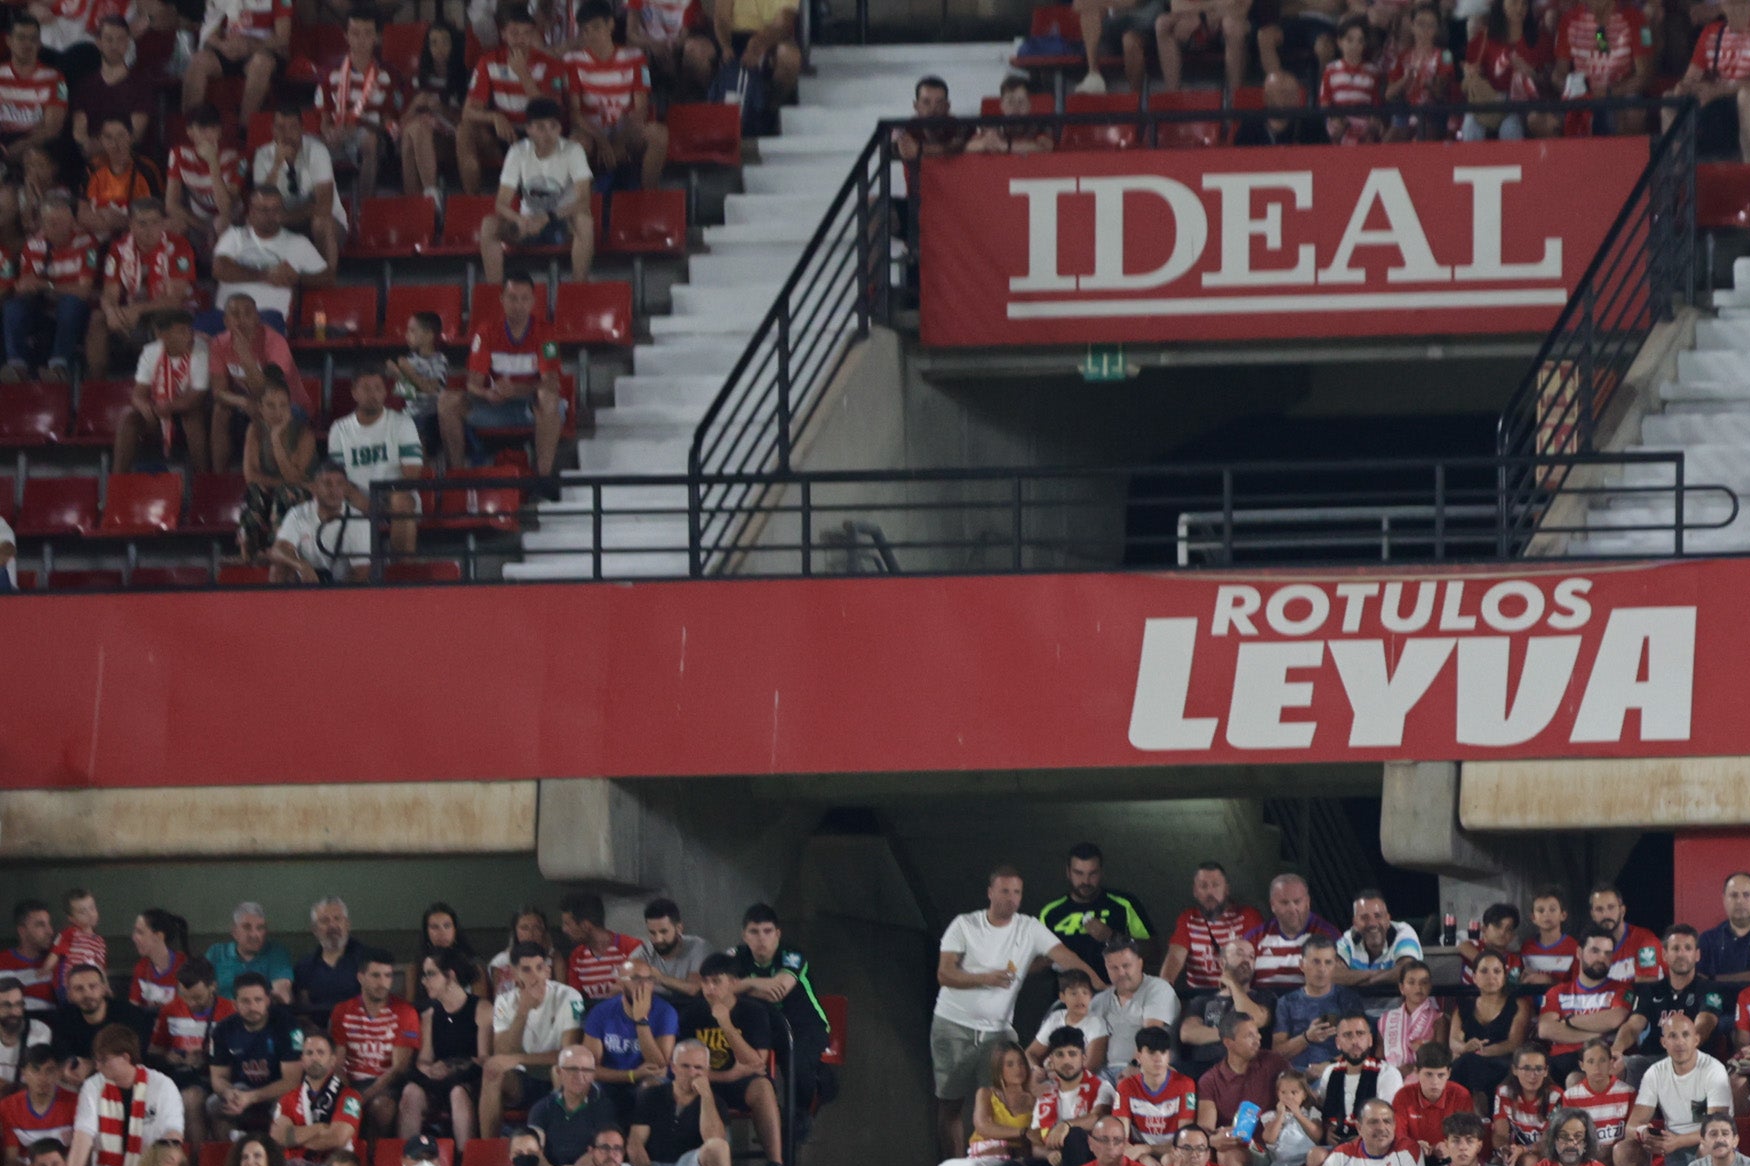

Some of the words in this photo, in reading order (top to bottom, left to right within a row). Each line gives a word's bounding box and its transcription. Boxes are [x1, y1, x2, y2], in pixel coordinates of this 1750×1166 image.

[1009, 166, 1563, 291] IDEAL
[1211, 578, 1592, 637] ROTULOS
[1128, 605, 1697, 750] LEYVA
[1597, 1121, 1625, 1139] atzi
